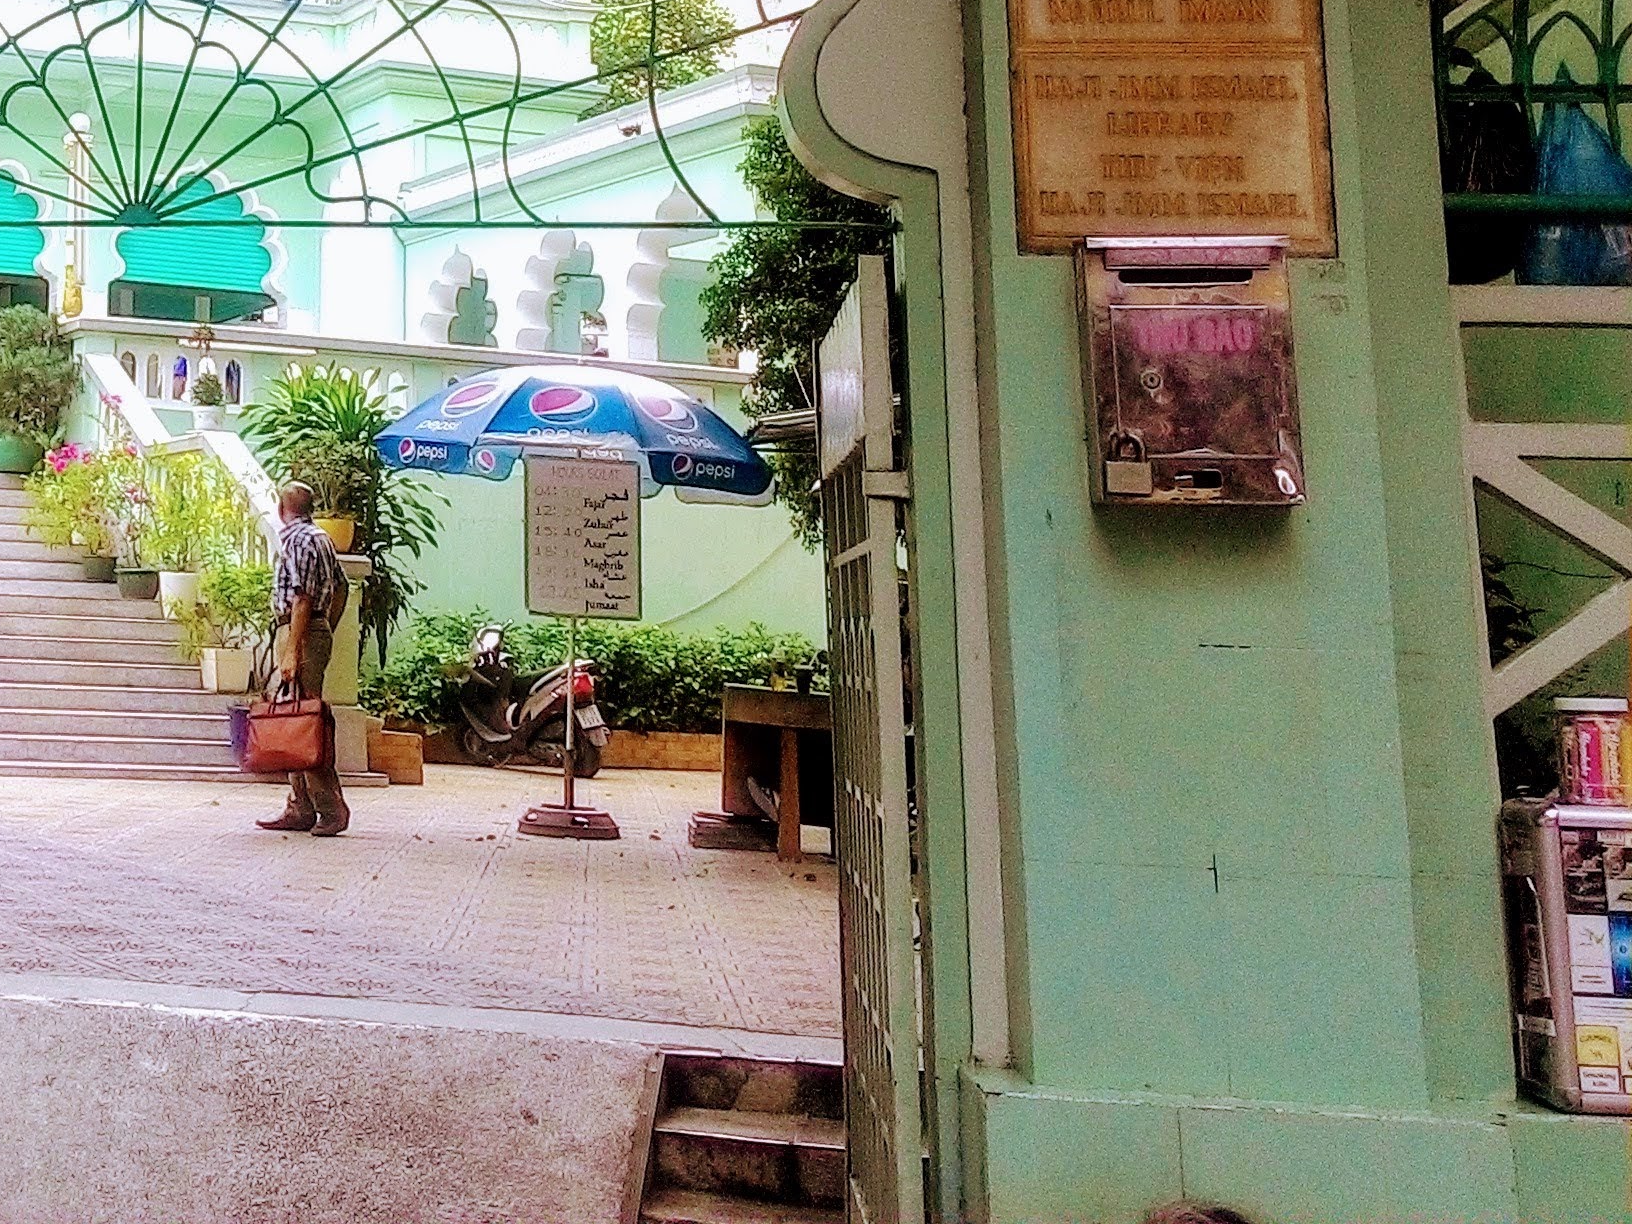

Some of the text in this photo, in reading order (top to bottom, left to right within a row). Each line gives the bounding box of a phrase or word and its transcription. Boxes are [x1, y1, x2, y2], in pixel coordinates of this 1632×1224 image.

[416, 418, 461, 432] pepsi
[667, 433, 718, 450] pepsi
[417, 444, 449, 460] pepsi
[696, 462, 736, 480] pepsi
[583, 538, 607, 549] Asar
[583, 557, 624, 573] Maghrib
[584, 600, 619, 614] Jumaat
